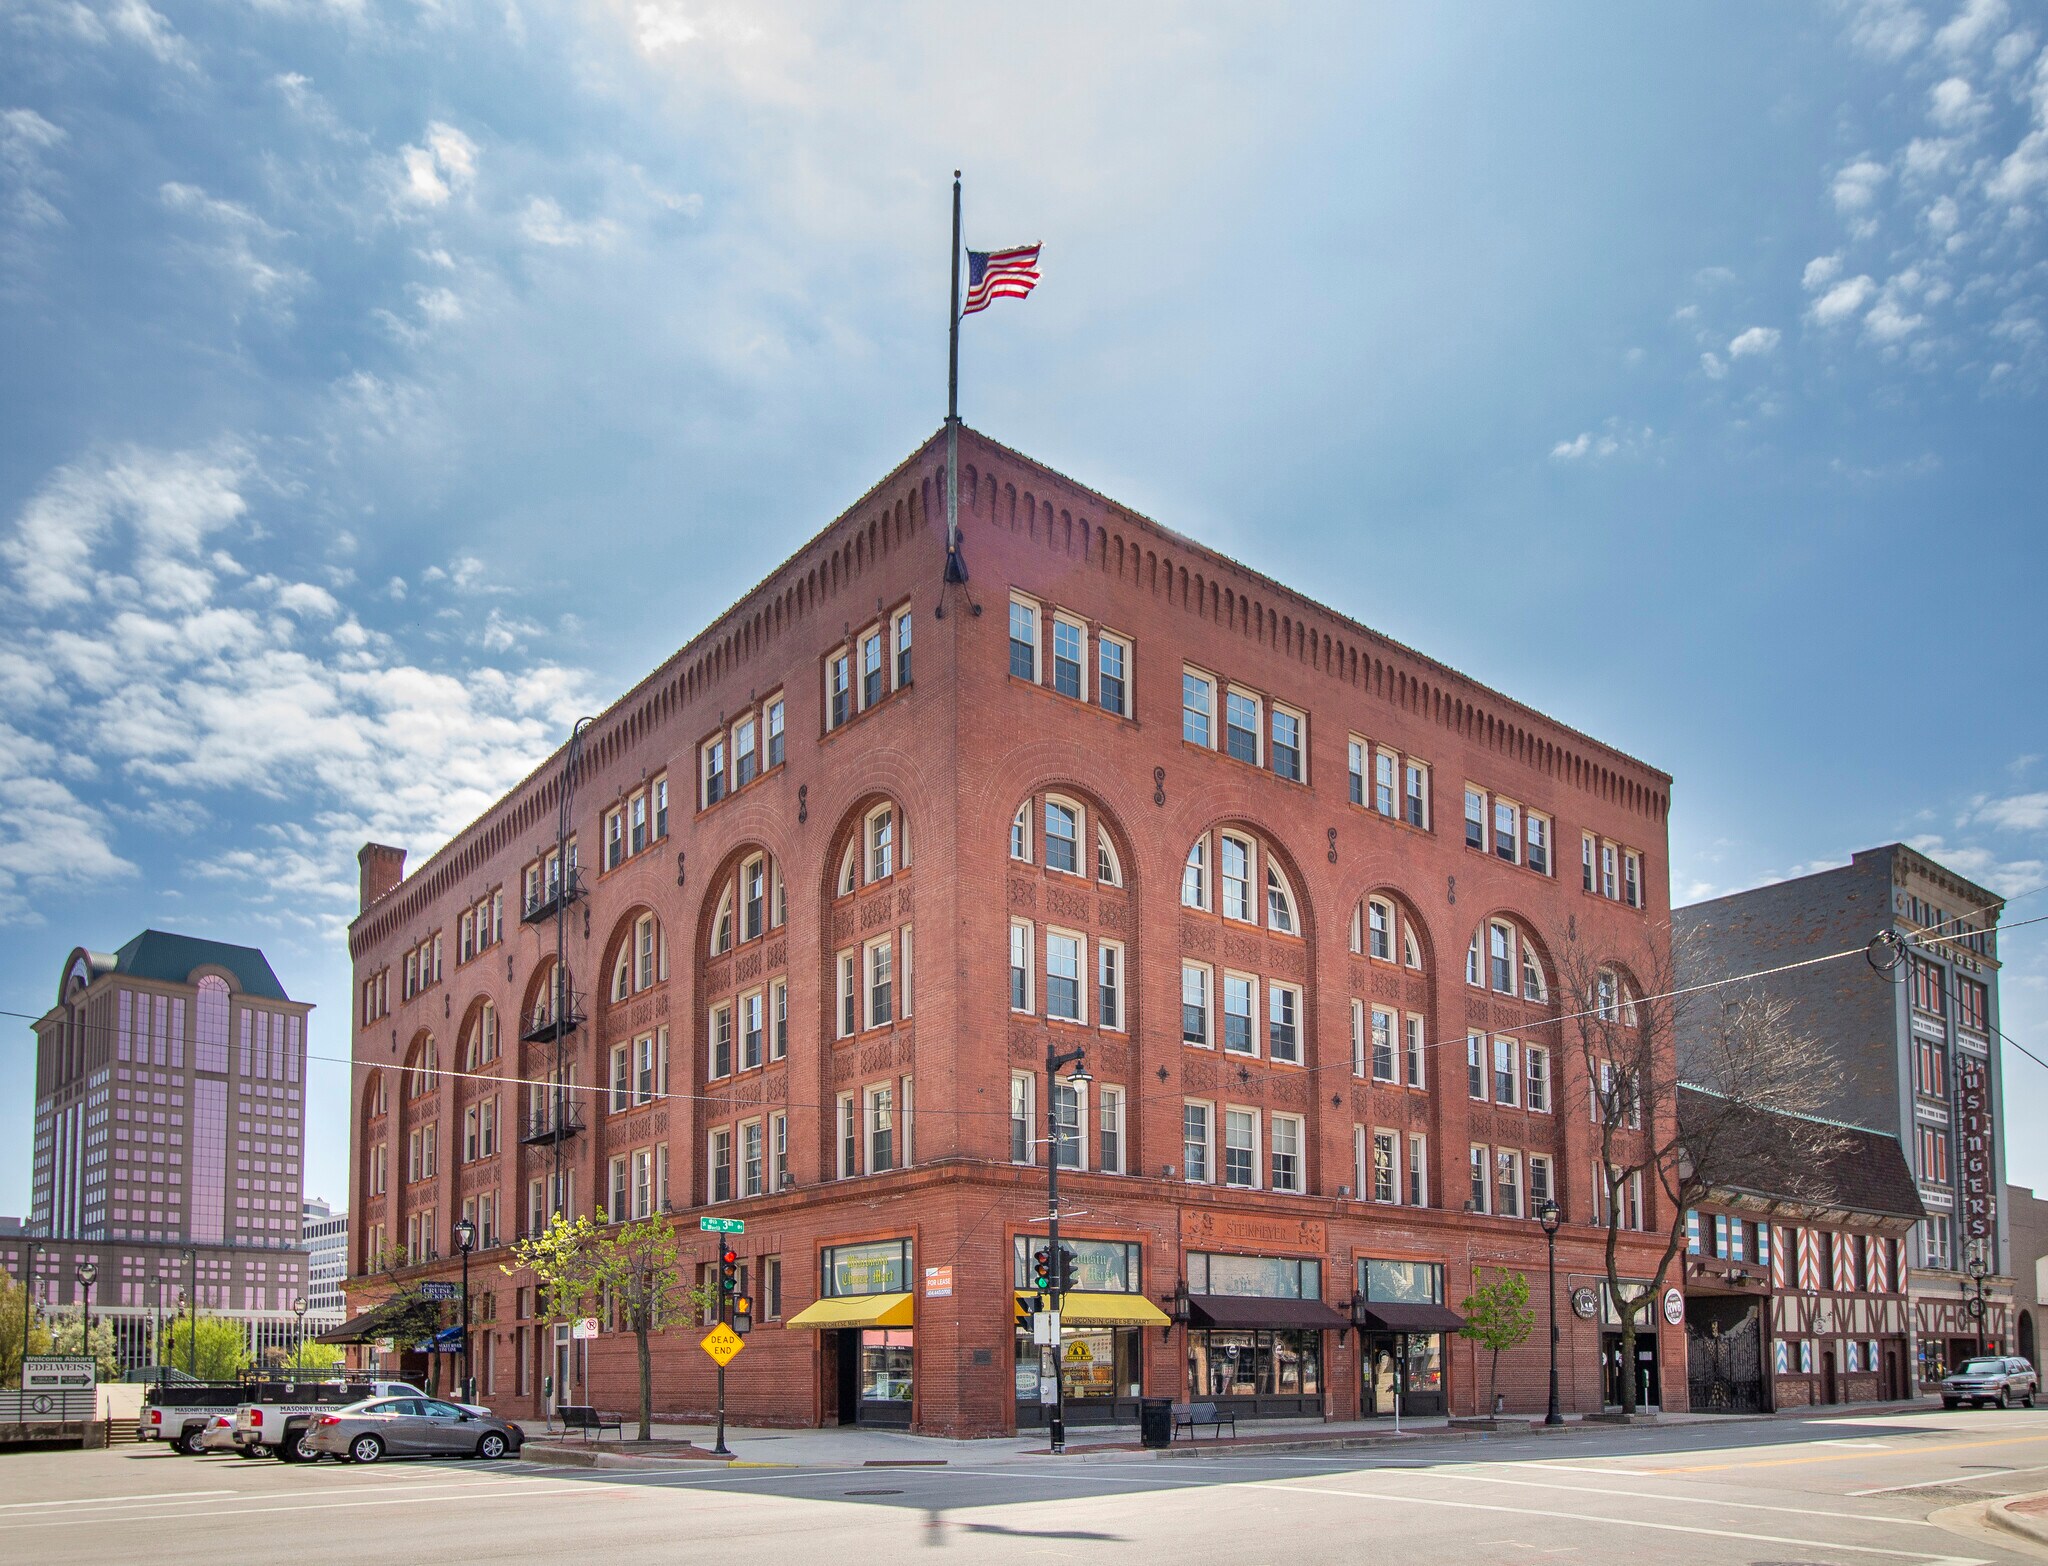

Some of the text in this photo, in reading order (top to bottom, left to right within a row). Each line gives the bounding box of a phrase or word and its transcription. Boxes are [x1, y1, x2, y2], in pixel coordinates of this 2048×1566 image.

[1227, 1222, 1287, 1240] STEINMEYER
[873, 1269, 894, 1284] Mart
[927, 1277, 951, 1287] FOR LEASE
[1667, 1301, 1682, 1314] RWB
[711, 1336, 735, 1344] DEAD
[714, 1346, 732, 1354] END
